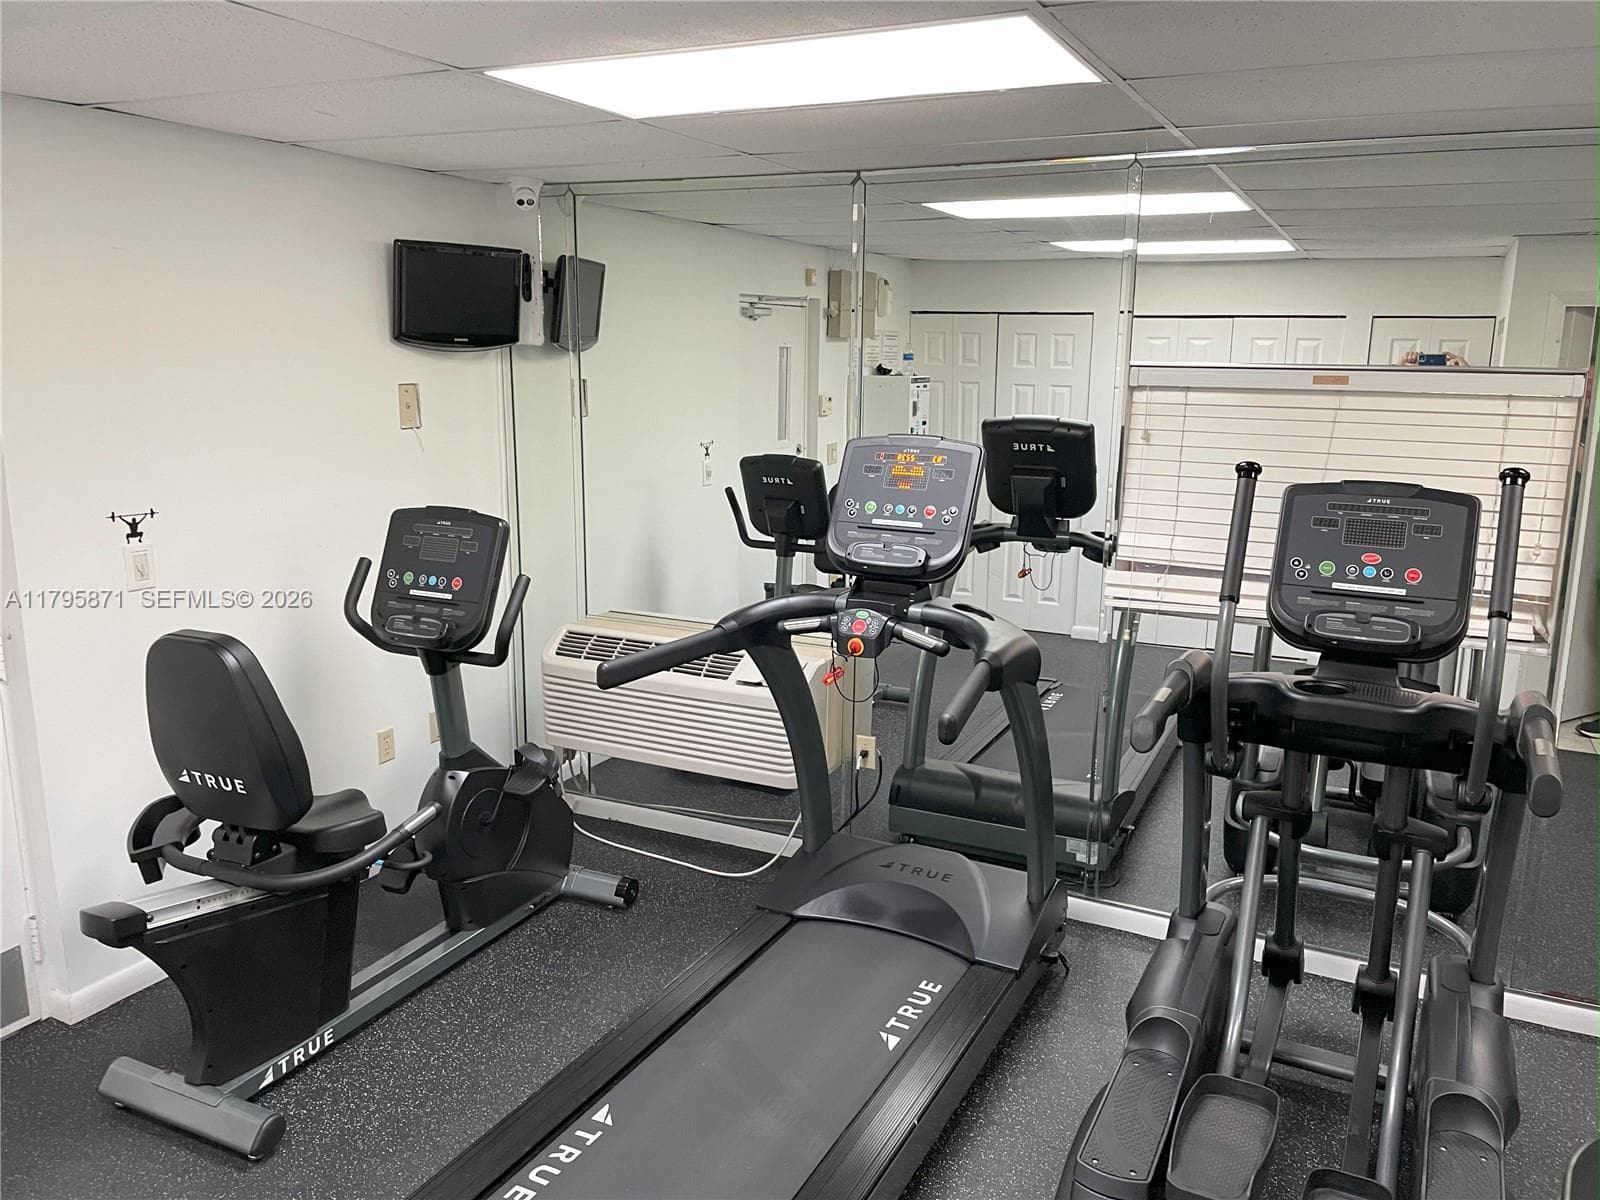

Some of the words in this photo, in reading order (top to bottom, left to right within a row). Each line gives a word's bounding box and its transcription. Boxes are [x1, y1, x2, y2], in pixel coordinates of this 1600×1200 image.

[191, 770, 247, 794] TRUE
[899, 862, 953, 883] TRUE
[886, 979, 942, 1032] TRUE
[278, 1028, 335, 1073] TRUE
[503, 1127, 604, 1200] TRUE
